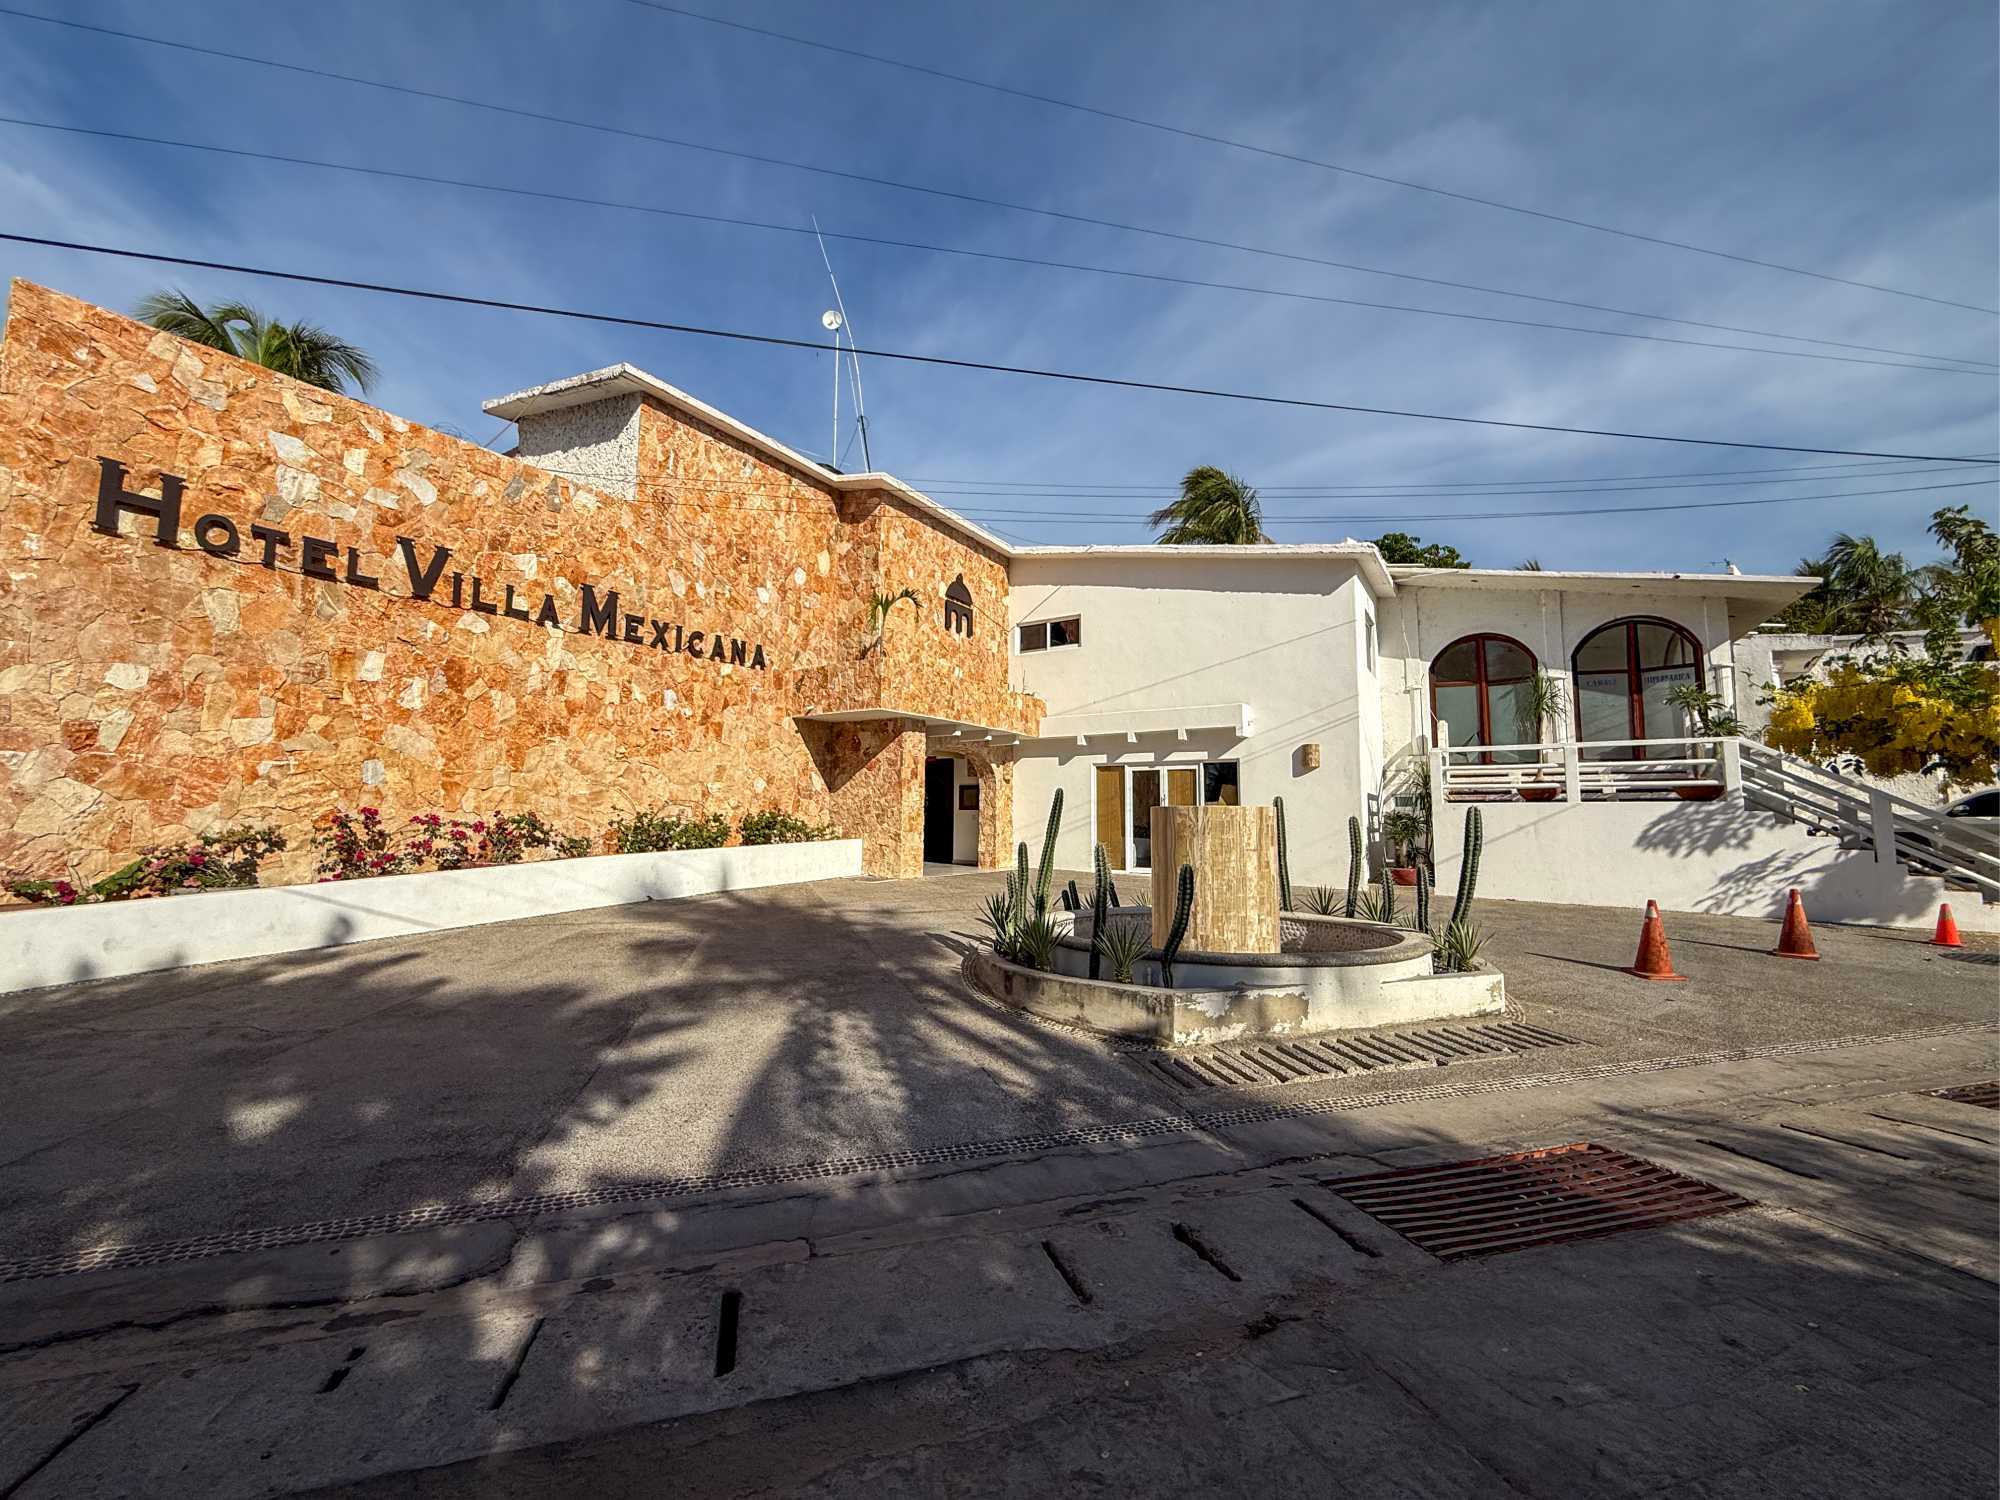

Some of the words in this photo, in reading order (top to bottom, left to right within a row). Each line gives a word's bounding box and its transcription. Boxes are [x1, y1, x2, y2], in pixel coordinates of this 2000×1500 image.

[92, 456, 379, 591] HOTEL
[396, 535, 560, 629] VILLA
[578, 583, 766, 670] MEXICANA
